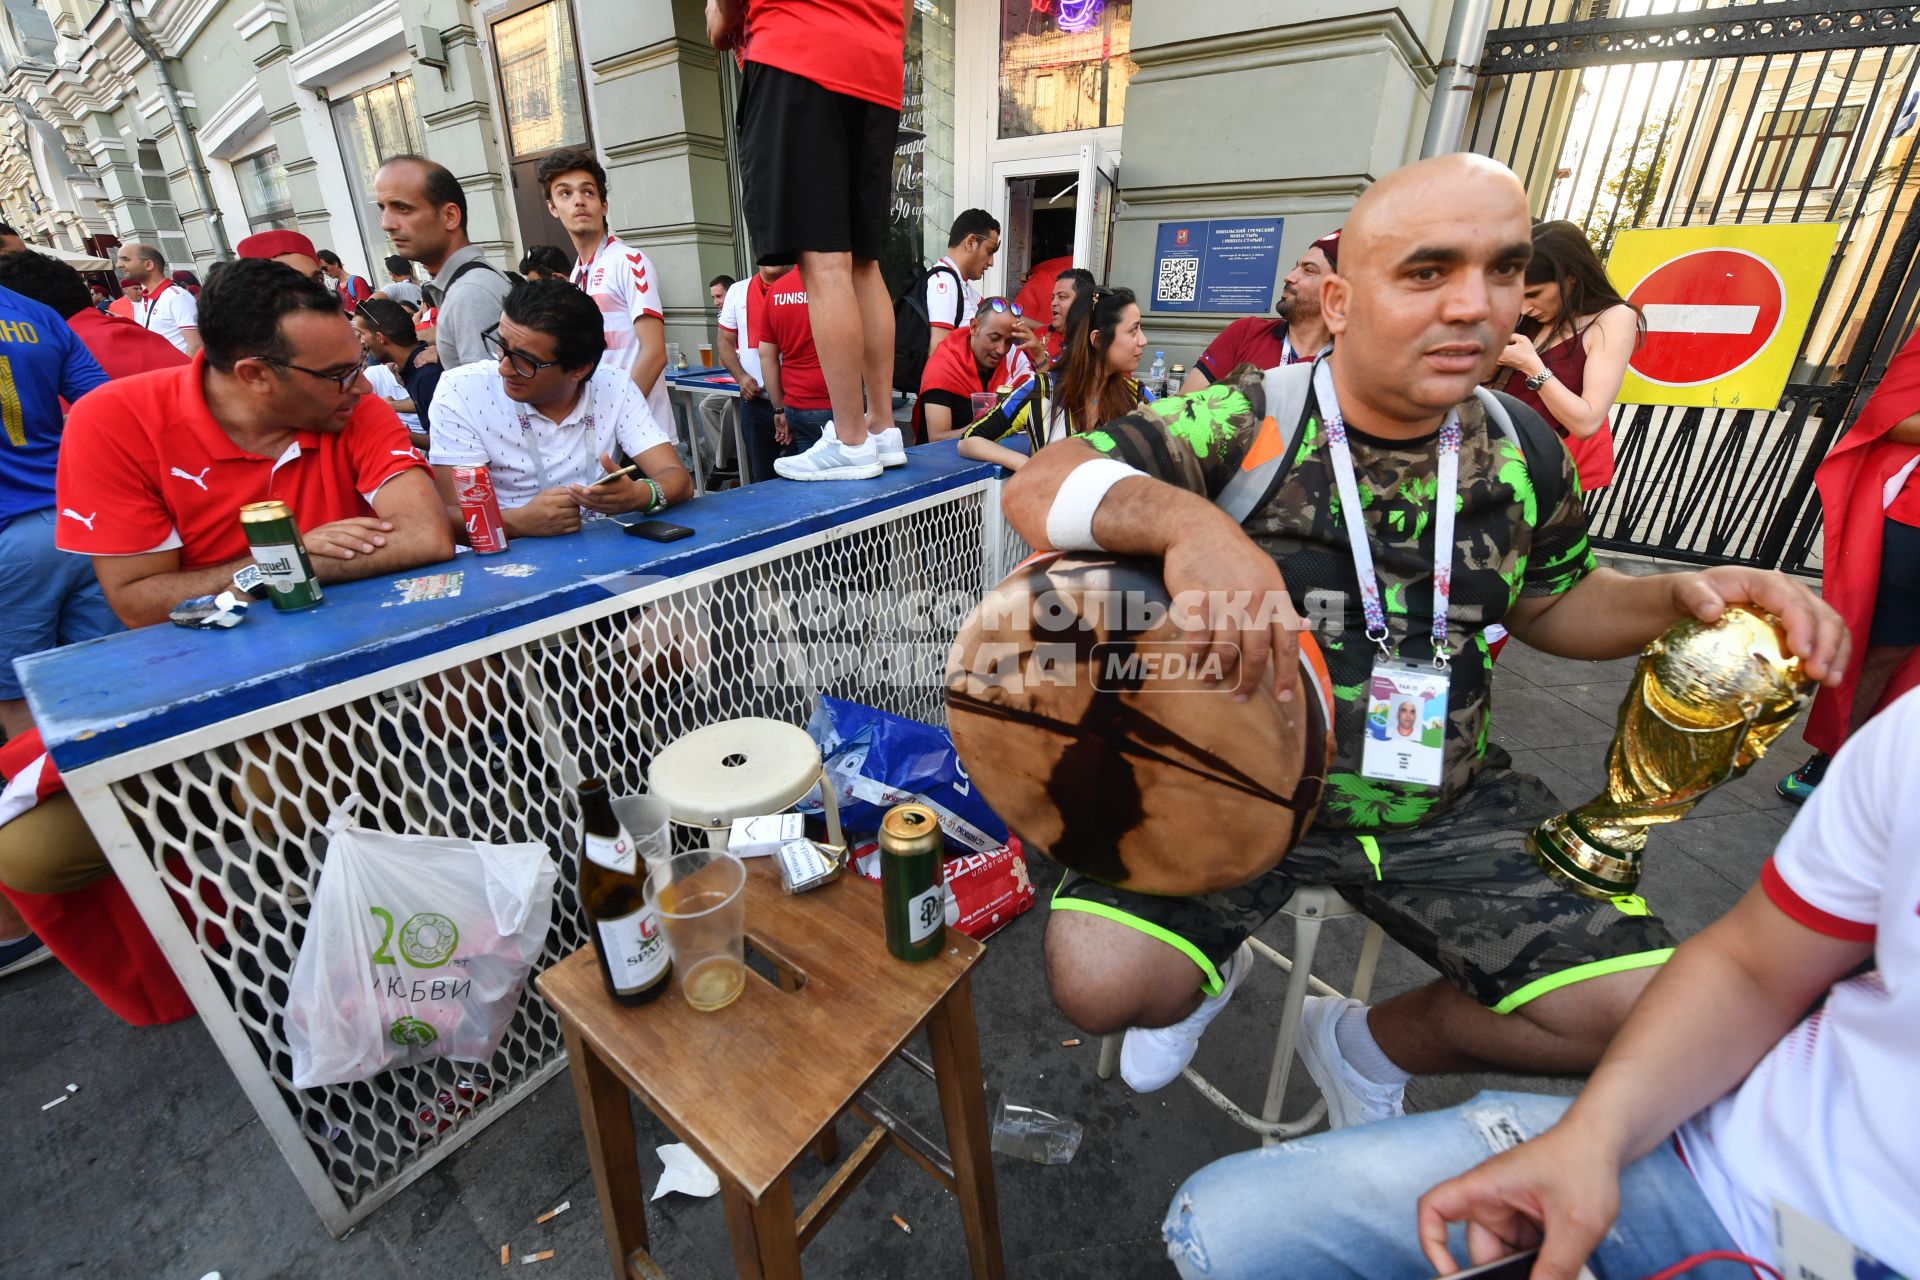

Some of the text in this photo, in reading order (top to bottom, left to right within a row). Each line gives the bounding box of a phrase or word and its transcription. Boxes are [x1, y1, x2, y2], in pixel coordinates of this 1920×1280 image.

[894, 197, 910, 225] 90
[773, 291, 809, 306] TUNISI
[0, 320, 38, 344] HO
[258, 557, 294, 578] rquell
[626, 937, 664, 967] SPAT
